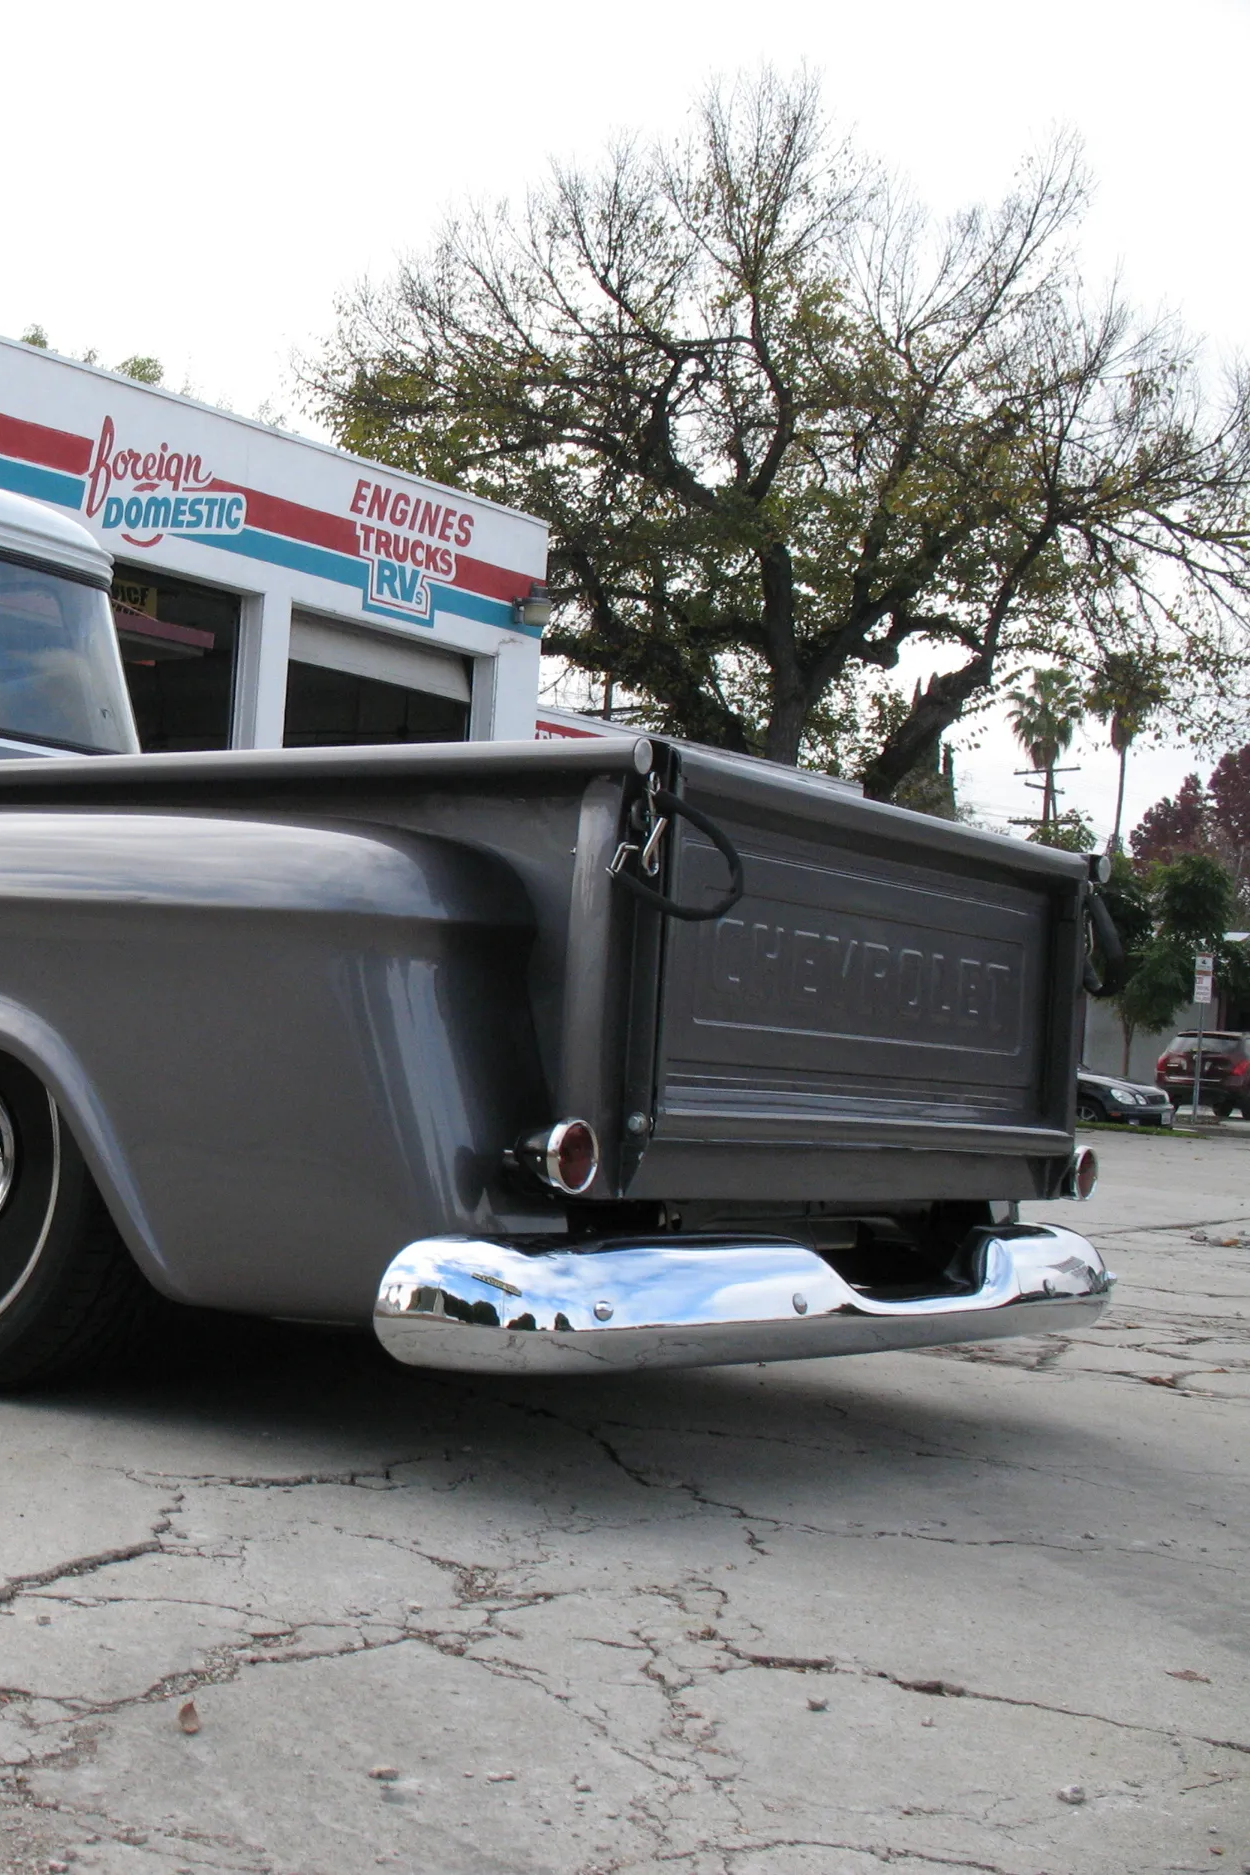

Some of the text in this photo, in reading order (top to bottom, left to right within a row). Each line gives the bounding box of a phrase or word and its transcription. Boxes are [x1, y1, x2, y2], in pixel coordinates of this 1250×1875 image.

[86, 415, 213, 519] foreign
[101, 496, 244, 530] DOMESTIC
[349, 478, 475, 548] ENGINES
[360, 523, 453, 577] TRUCKS
[713, 916, 1011, 1029] CHEVROLET
